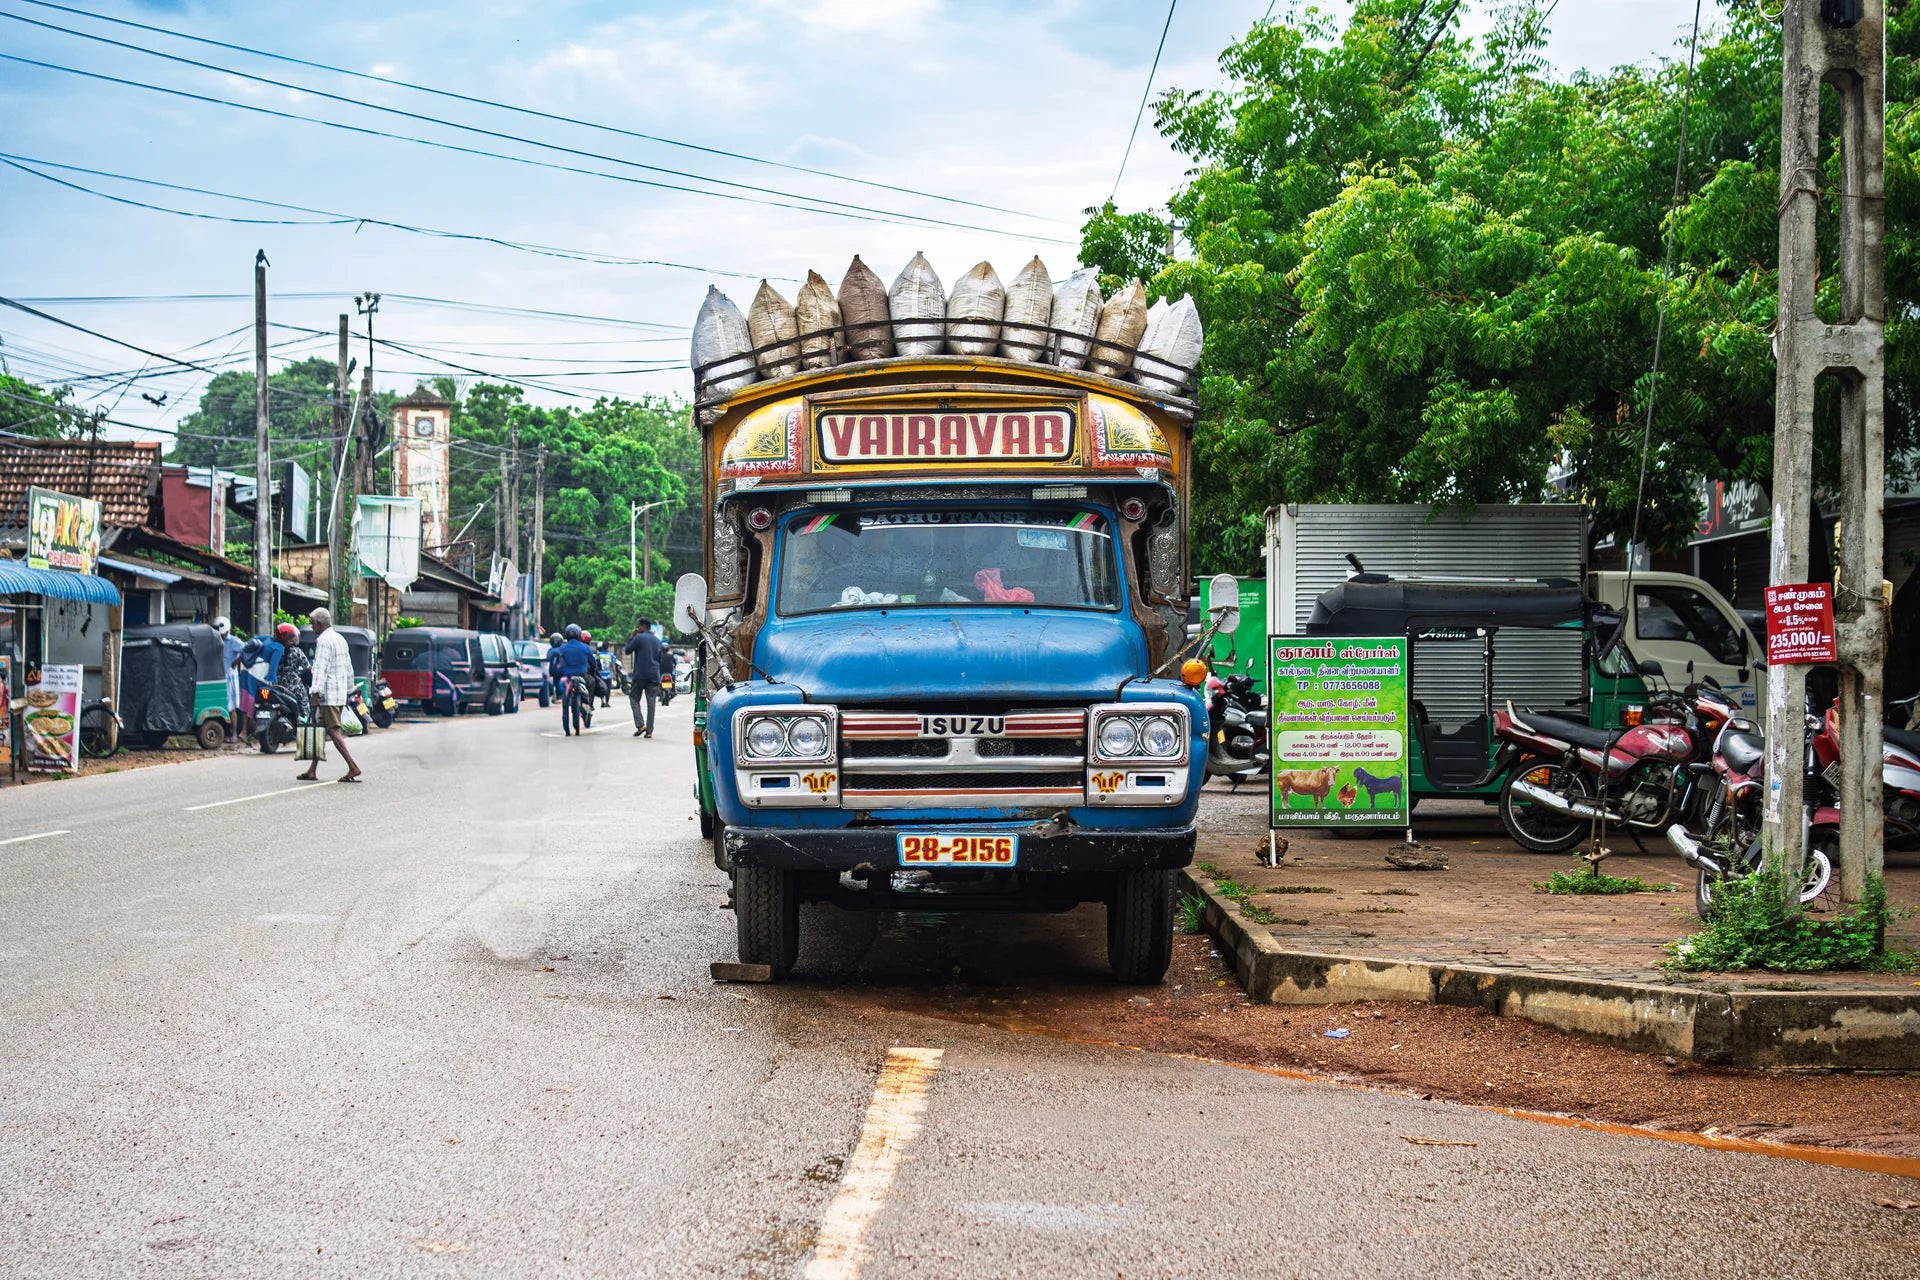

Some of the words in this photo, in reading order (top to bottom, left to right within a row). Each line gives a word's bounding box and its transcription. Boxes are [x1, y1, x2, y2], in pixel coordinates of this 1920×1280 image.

[827, 414, 1064, 457] VAIRAVAR
[856, 513, 942, 526] SATHU
[1777, 586, 1826, 602] சண்முகம்
[1793, 602, 1823, 611] சேவை
[1770, 631, 1831, 649] 235,000/=
[1277, 642, 1336, 660] ஞானம்
[1340, 645, 1399, 660] ஸ்ரோர்ஸ்
[1278, 665, 1314, 677] கால்நடை
[1317, 664, 1339, 677] தீவன
[1341, 664, 1399, 678] விற்பனையாளர்
[1297, 682, 1309, 690] TP
[1323, 681, 1380, 690] 0773656088
[1363, 698, 1376, 707] மீன்
[1278, 712, 1317, 724] தீவனங்கள்
[1319, 712, 1350, 725] விற்பனை
[1351, 711, 1396, 723] செய்யப்படும்
[923, 717, 1004, 735] ISUZU
[1278, 811, 1320, 820] மானிப்பாய்
[1344, 811, 1401, 821] மருதனார்மடம்
[904, 837, 1011, 862] 28-2156
